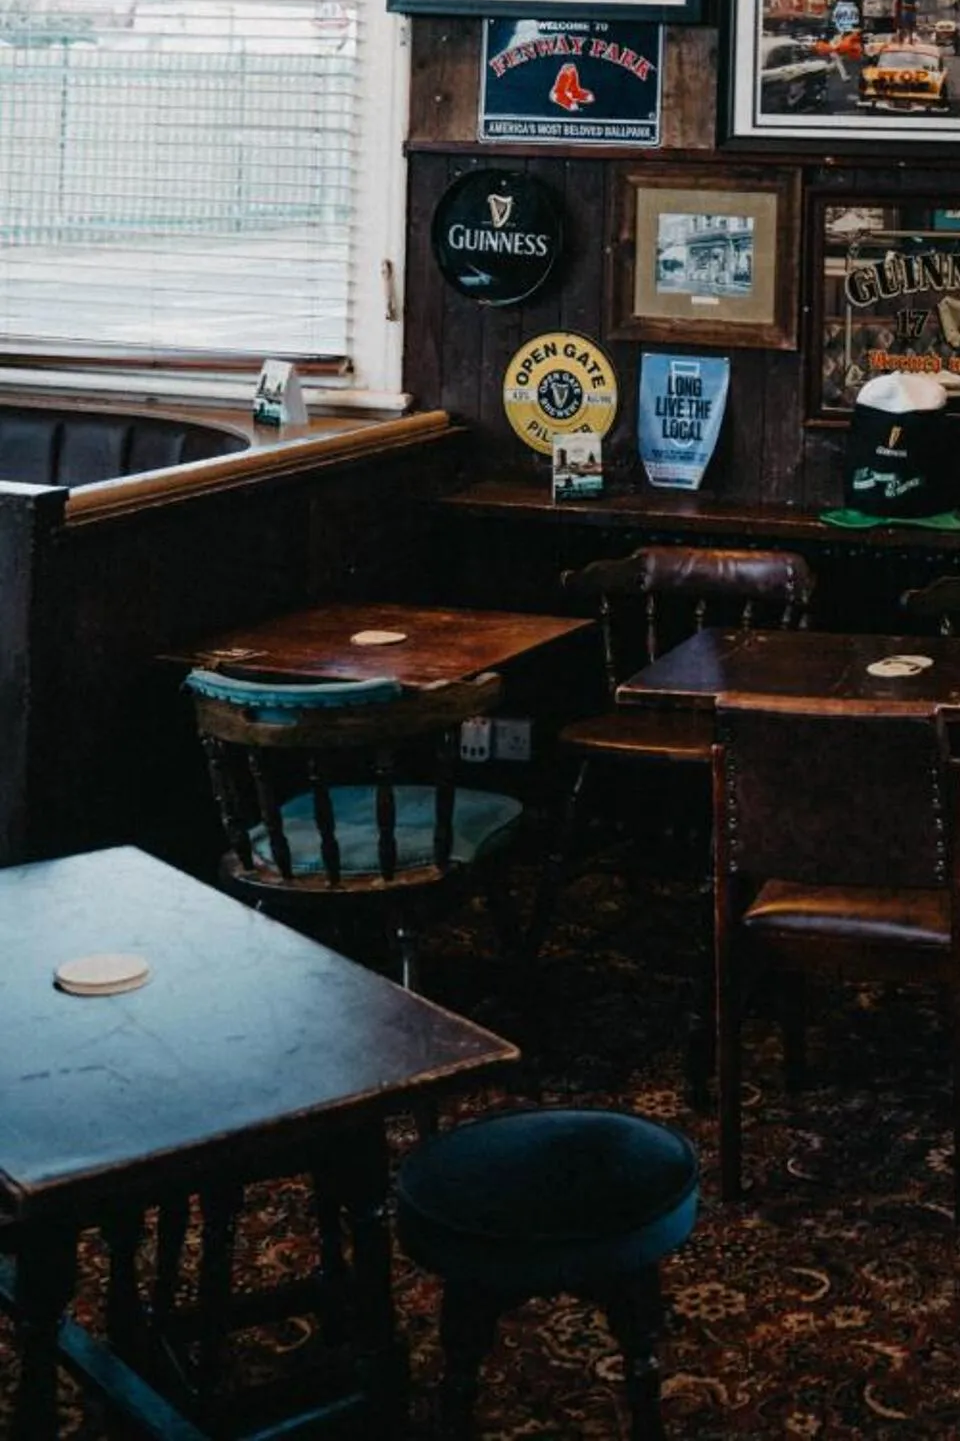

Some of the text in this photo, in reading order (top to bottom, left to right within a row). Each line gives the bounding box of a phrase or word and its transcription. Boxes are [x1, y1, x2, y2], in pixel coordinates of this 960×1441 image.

[488, 33, 656, 82] FENWAY PARK
[538, 124, 562, 136] MOST
[563, 124, 604, 137] BELOVED
[448, 223, 548, 257] GUINNESS
[896, 309, 929, 340] 17
[515, 341, 606, 389] OPEN GATE
[667, 375, 703, 398] LONG
[655, 396, 713, 421] LIVE THE
[661, 418, 703, 441] LOCAL
